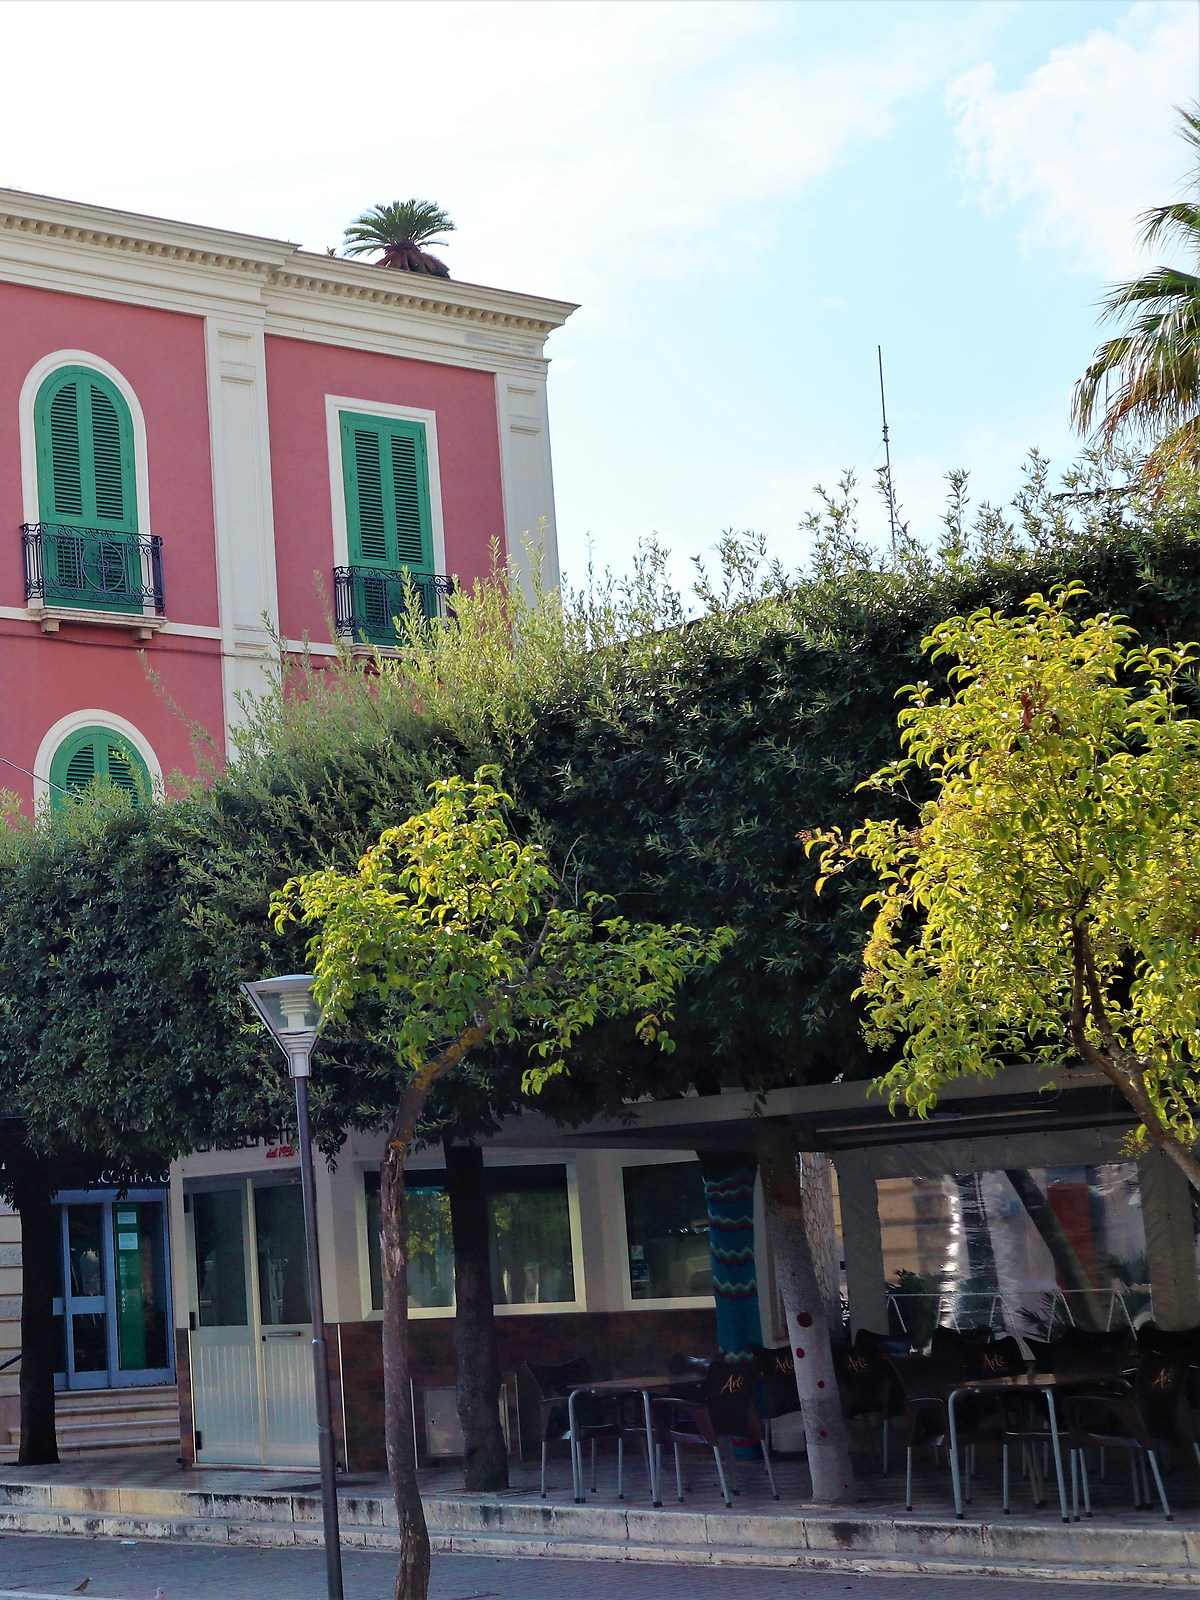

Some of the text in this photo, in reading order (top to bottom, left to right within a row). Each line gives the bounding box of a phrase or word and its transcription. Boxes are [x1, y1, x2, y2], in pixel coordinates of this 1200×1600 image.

[279, 1146, 295, 1158] 1950
[847, 1354, 868, 1373] Arte
[983, 1353, 1006, 1373] Arte
